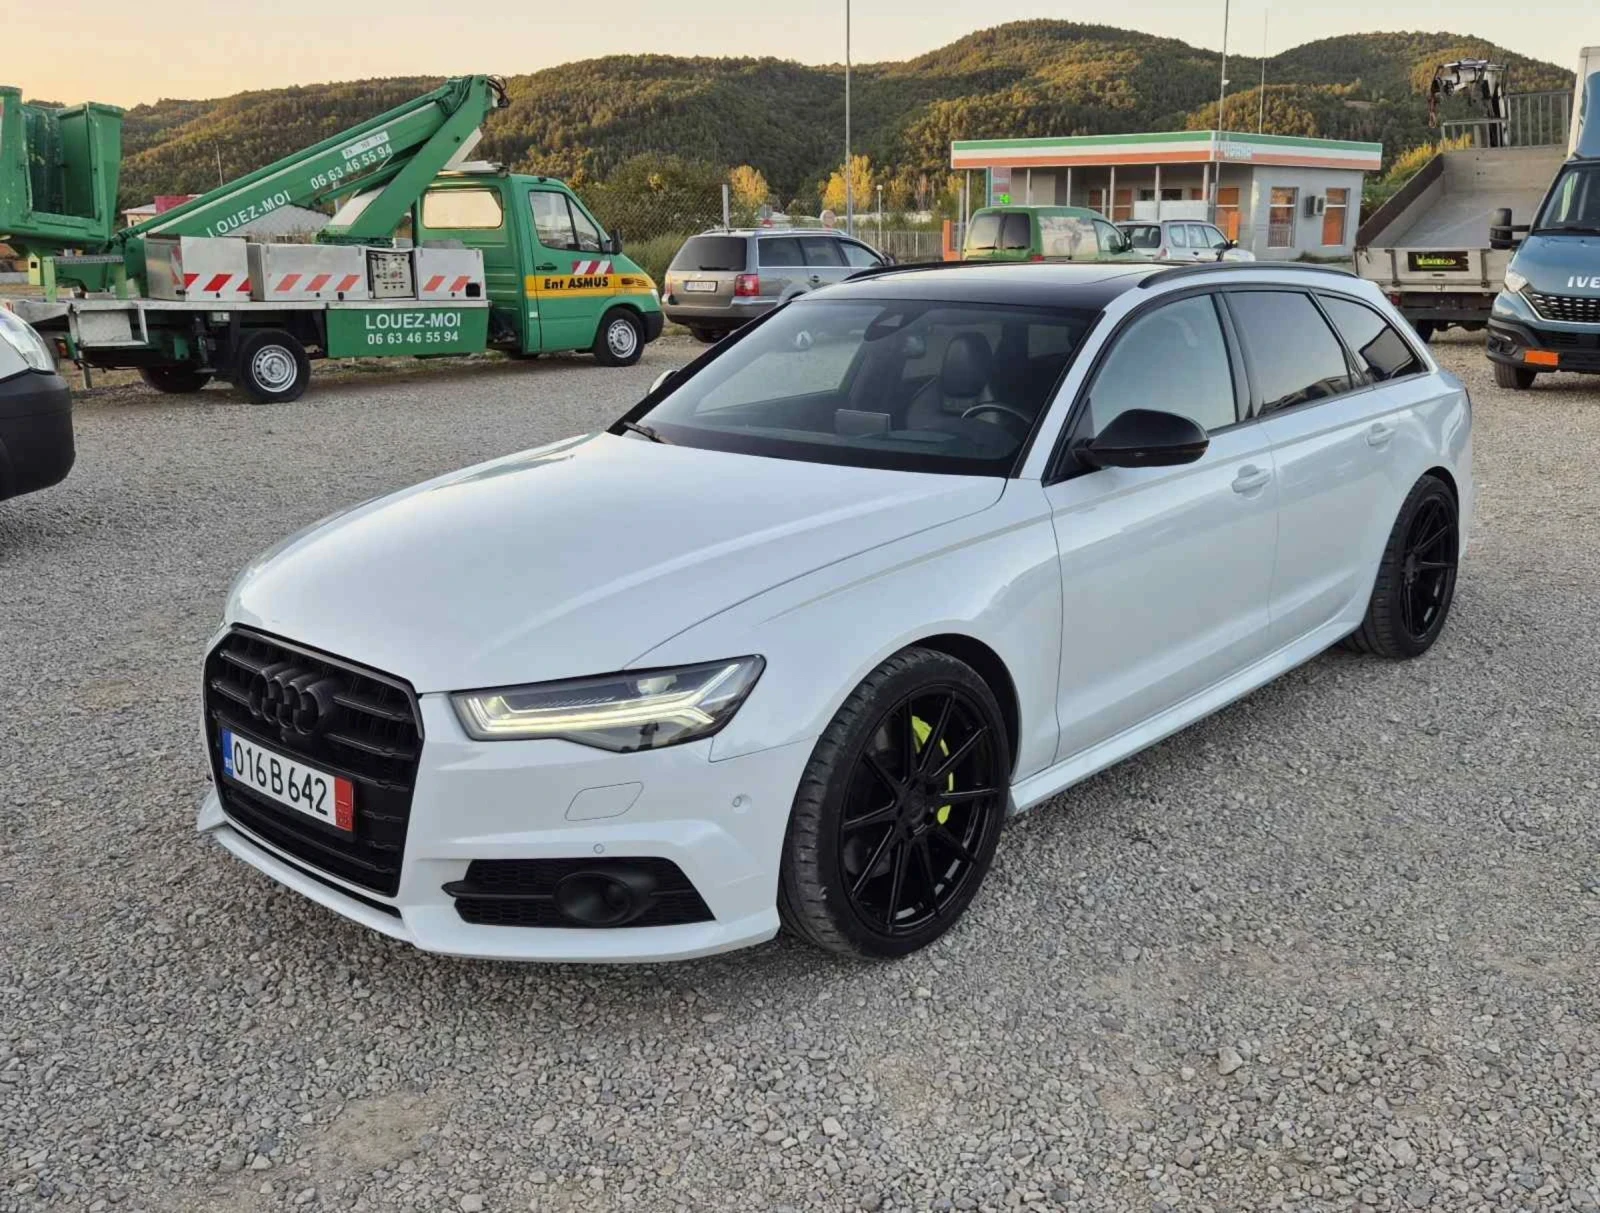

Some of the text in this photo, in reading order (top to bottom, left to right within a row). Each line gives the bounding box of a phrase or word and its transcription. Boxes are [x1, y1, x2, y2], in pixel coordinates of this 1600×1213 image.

[311, 175, 327, 190] 06
[328, 167, 344, 181] 63
[345, 158, 361, 174] 46
[361, 150, 377, 166] 55
[378, 143, 393, 158] 94
[206, 190, 291, 238] LOUEZ-MOI
[568, 276, 608, 289] ASMUS
[365, 312, 461, 330] LOUEZ-MOI
[367, 331, 459, 345] 06 63 46 55 94
